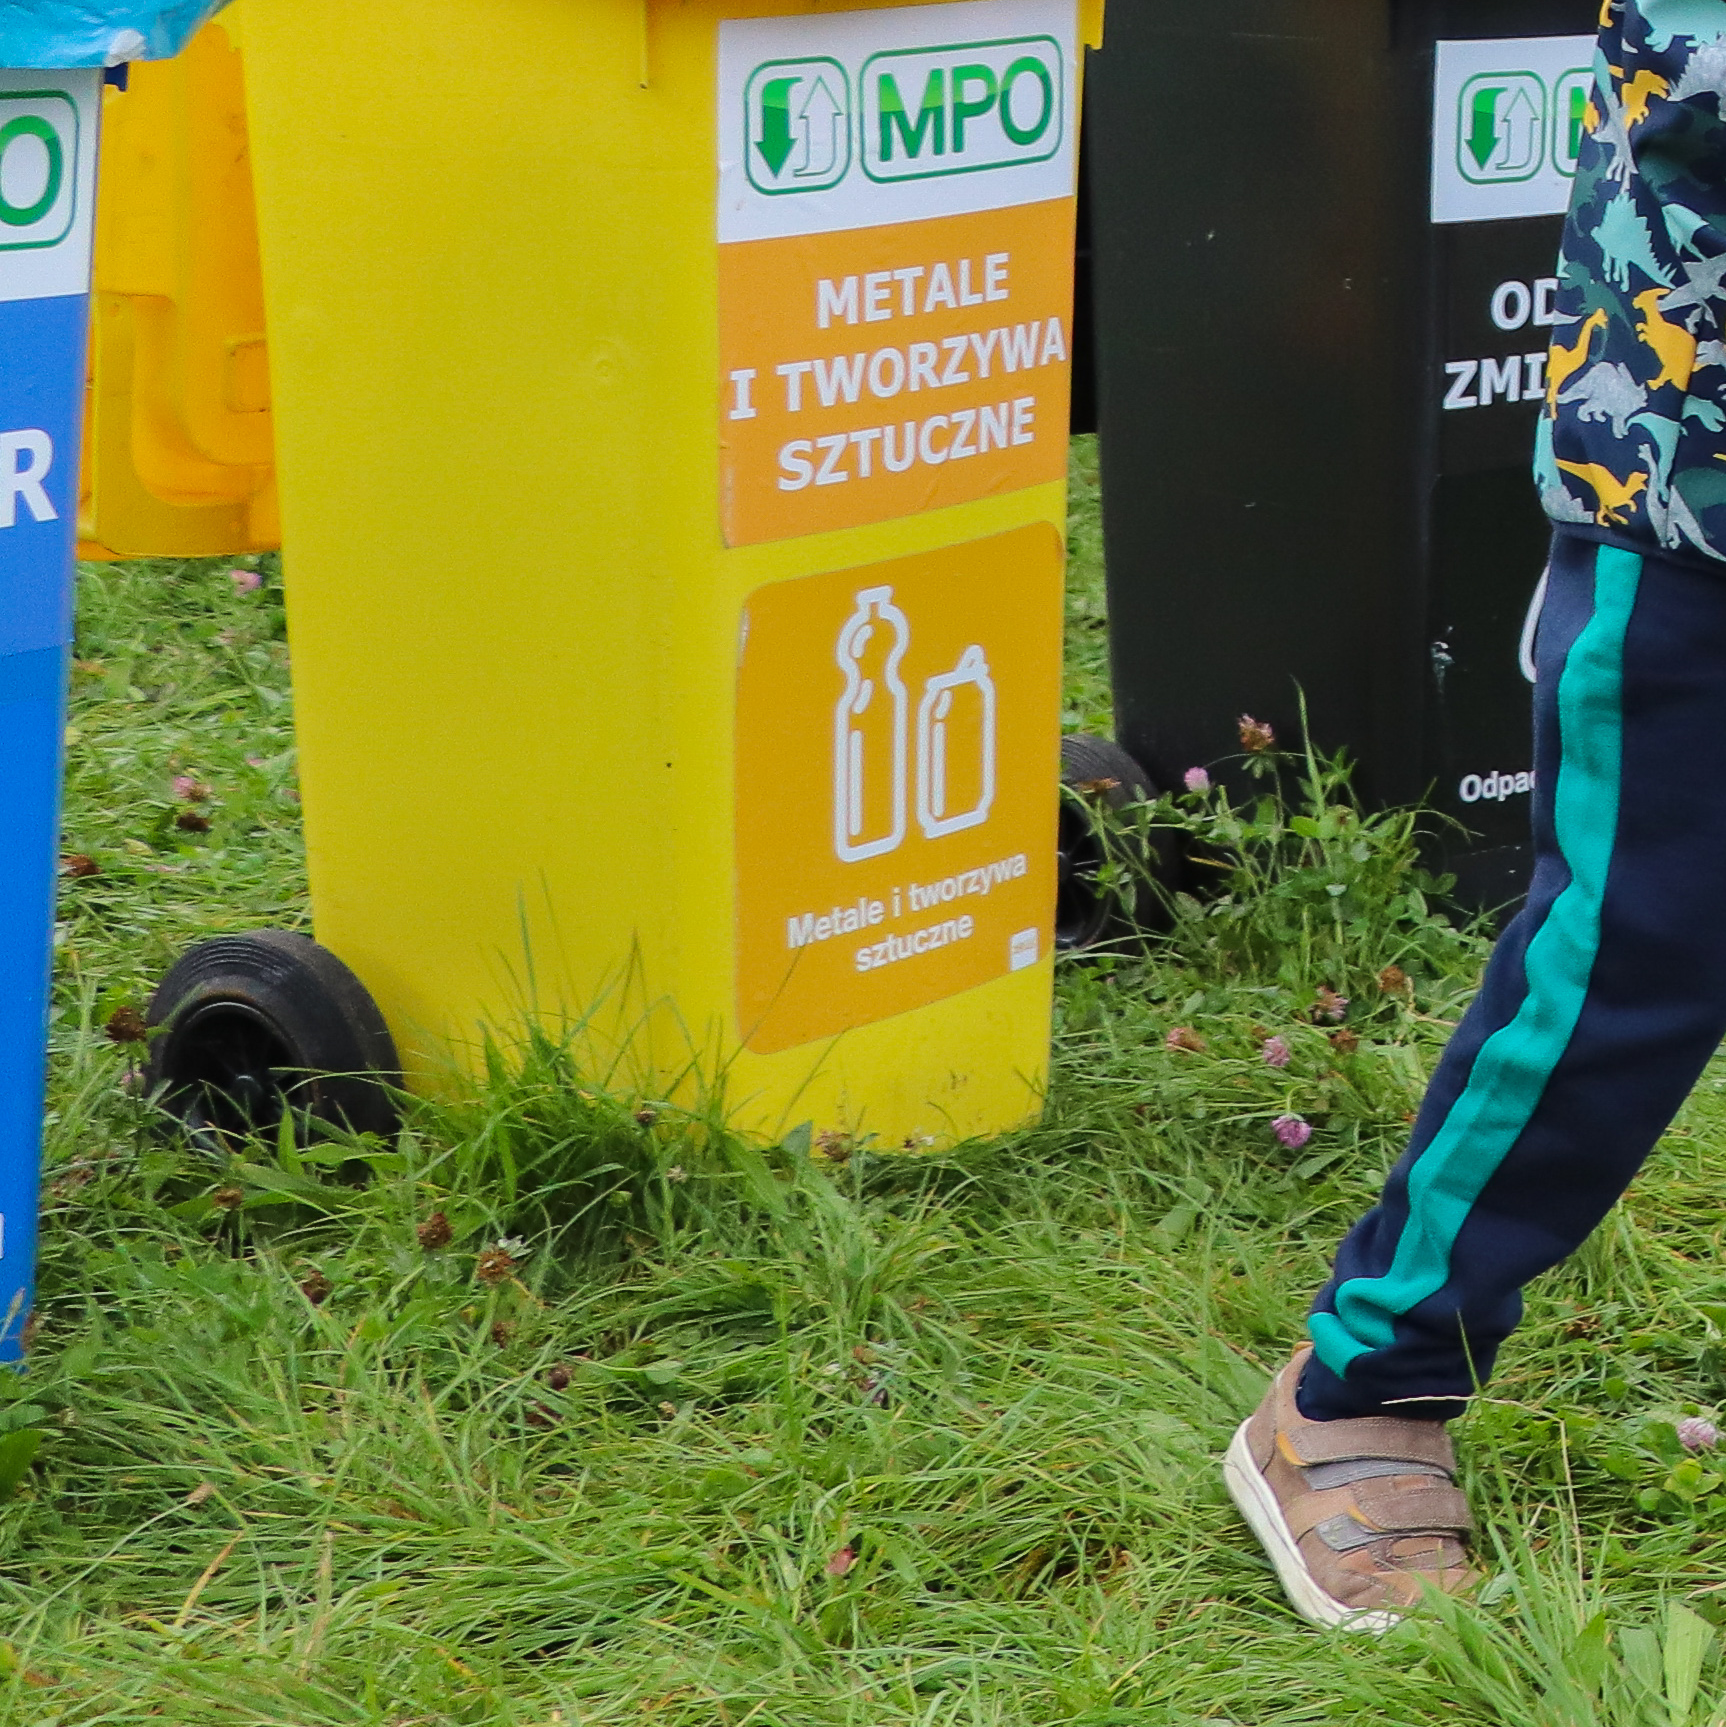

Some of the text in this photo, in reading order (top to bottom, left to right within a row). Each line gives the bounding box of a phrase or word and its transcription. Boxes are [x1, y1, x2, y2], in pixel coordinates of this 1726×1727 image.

[878, 56, 1054, 163] MPO
[817, 252, 1011, 329] METALE
[728, 317, 1067, 421] I TWORZYWA
[777, 396, 1036, 492] SZTUCZNE
[787, 852, 1029, 949] Metale i tworzywa
[855, 913, 975, 973] sztuczne
